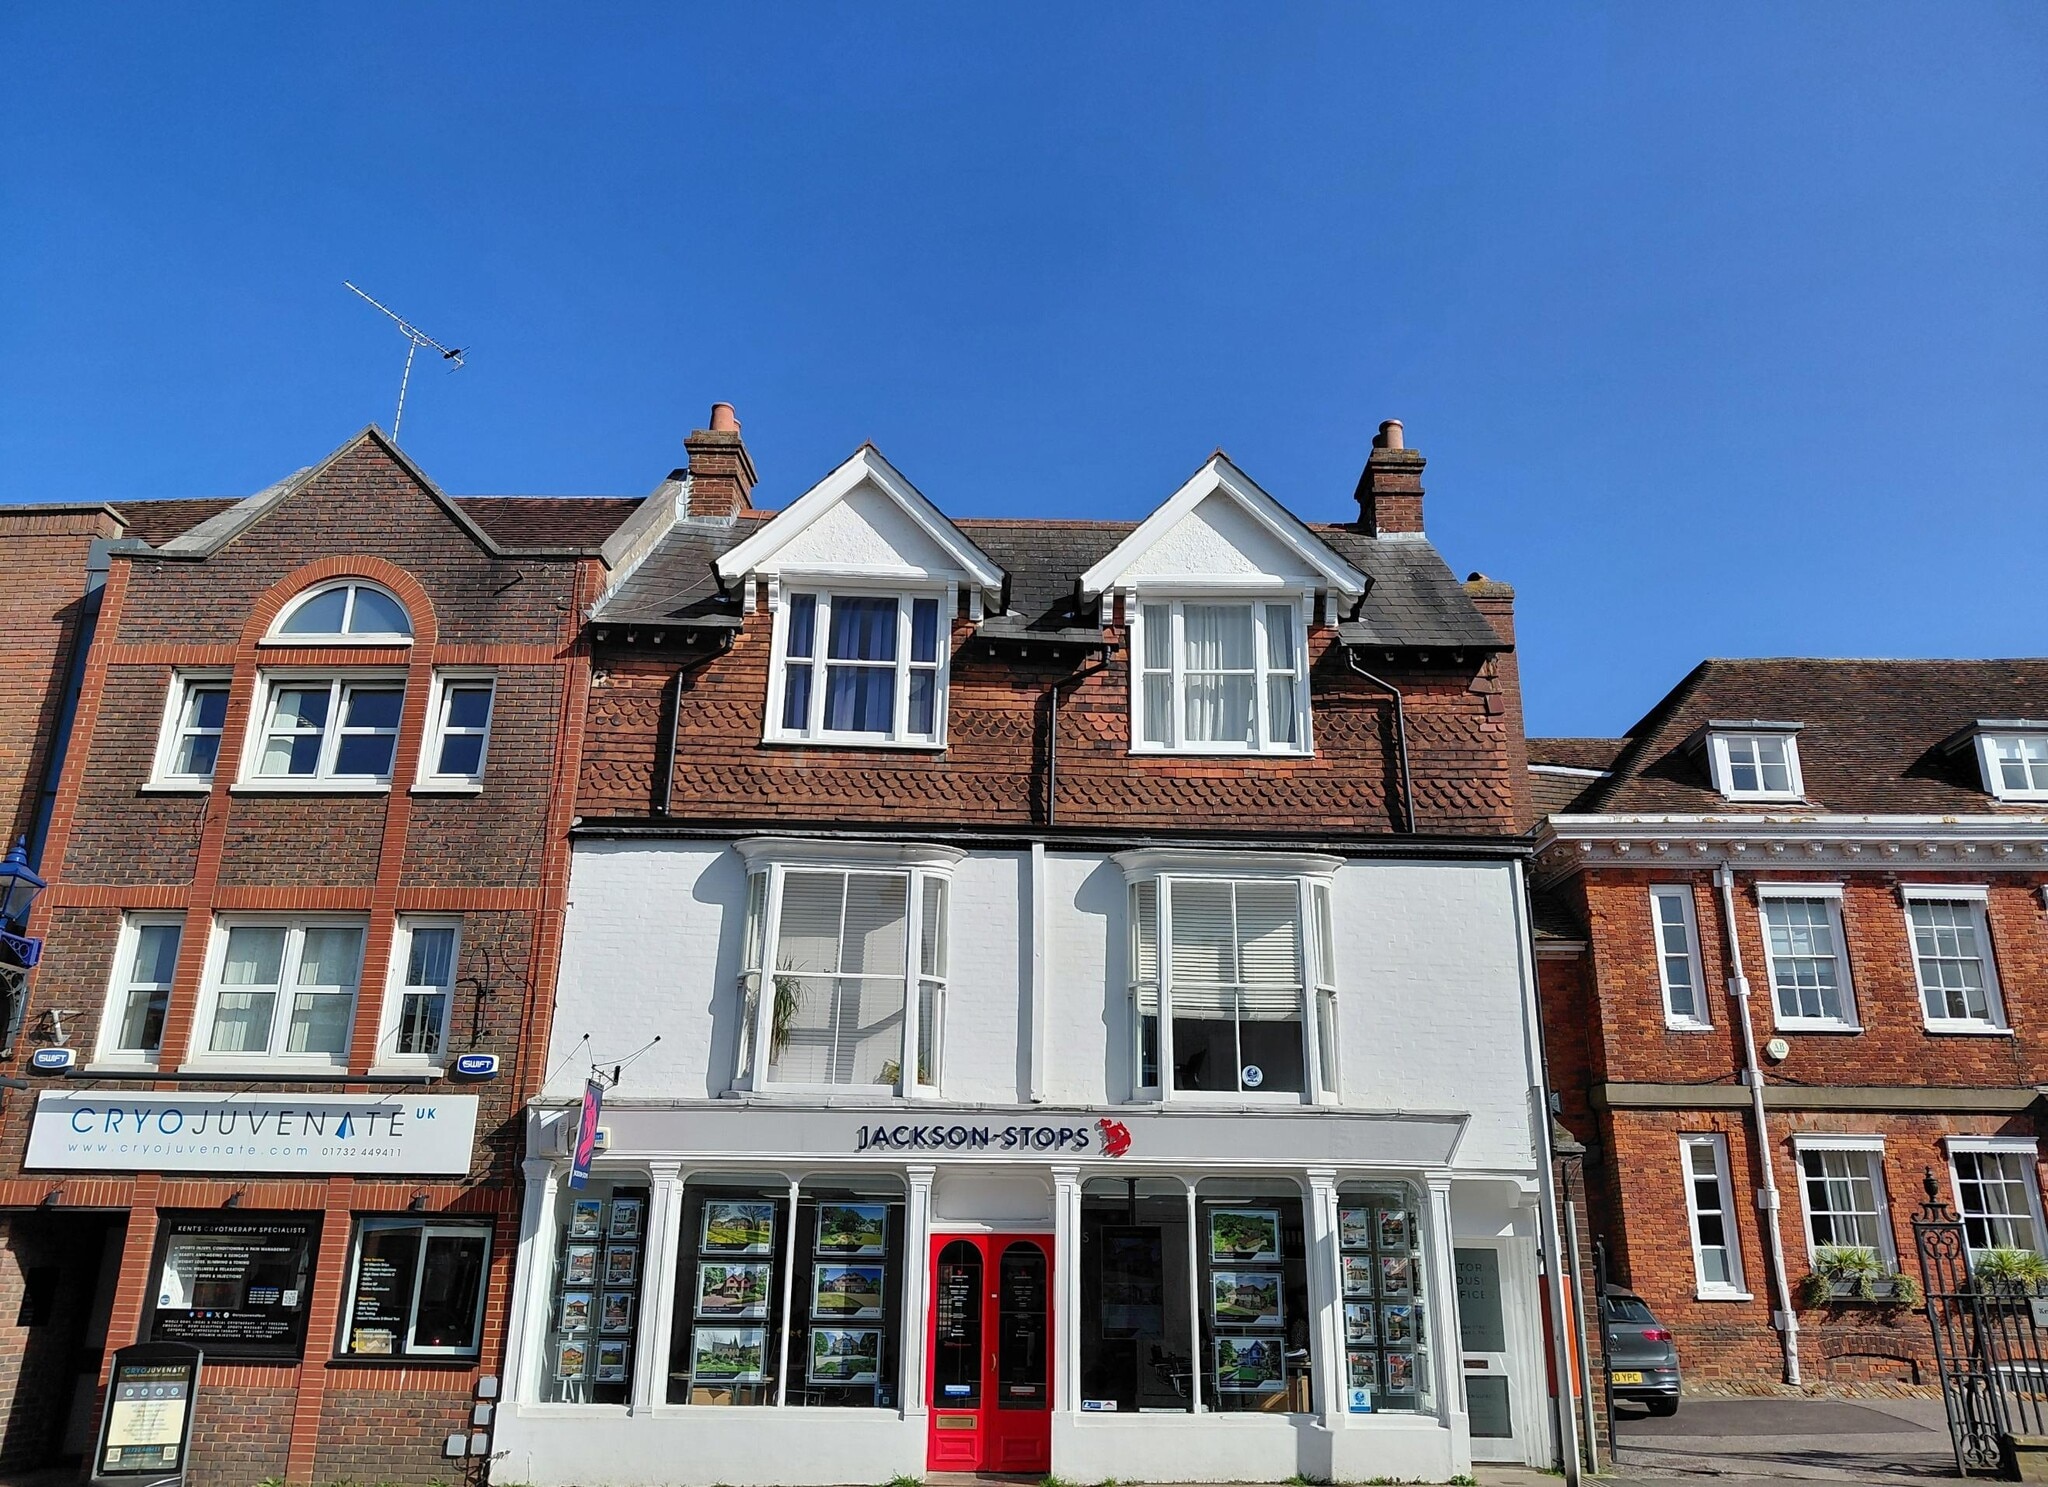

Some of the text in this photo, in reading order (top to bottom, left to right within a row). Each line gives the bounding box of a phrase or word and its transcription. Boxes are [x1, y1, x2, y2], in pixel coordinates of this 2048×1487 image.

[38, 1054, 67, 1063] SWIFT
[462, 1059, 492, 1069] SWIFT
[71, 1107, 437, 1140] CRYOJUVENATE UK
[858, 1125, 1089, 1150] JACKSON-STOPS
[68, 1142, 402, 1158] www.cryojuvenate.com 01732 449411
[259, 1226, 306, 1234] SPECIALISTS
[1621, 1373, 1639, 1382] YPC
